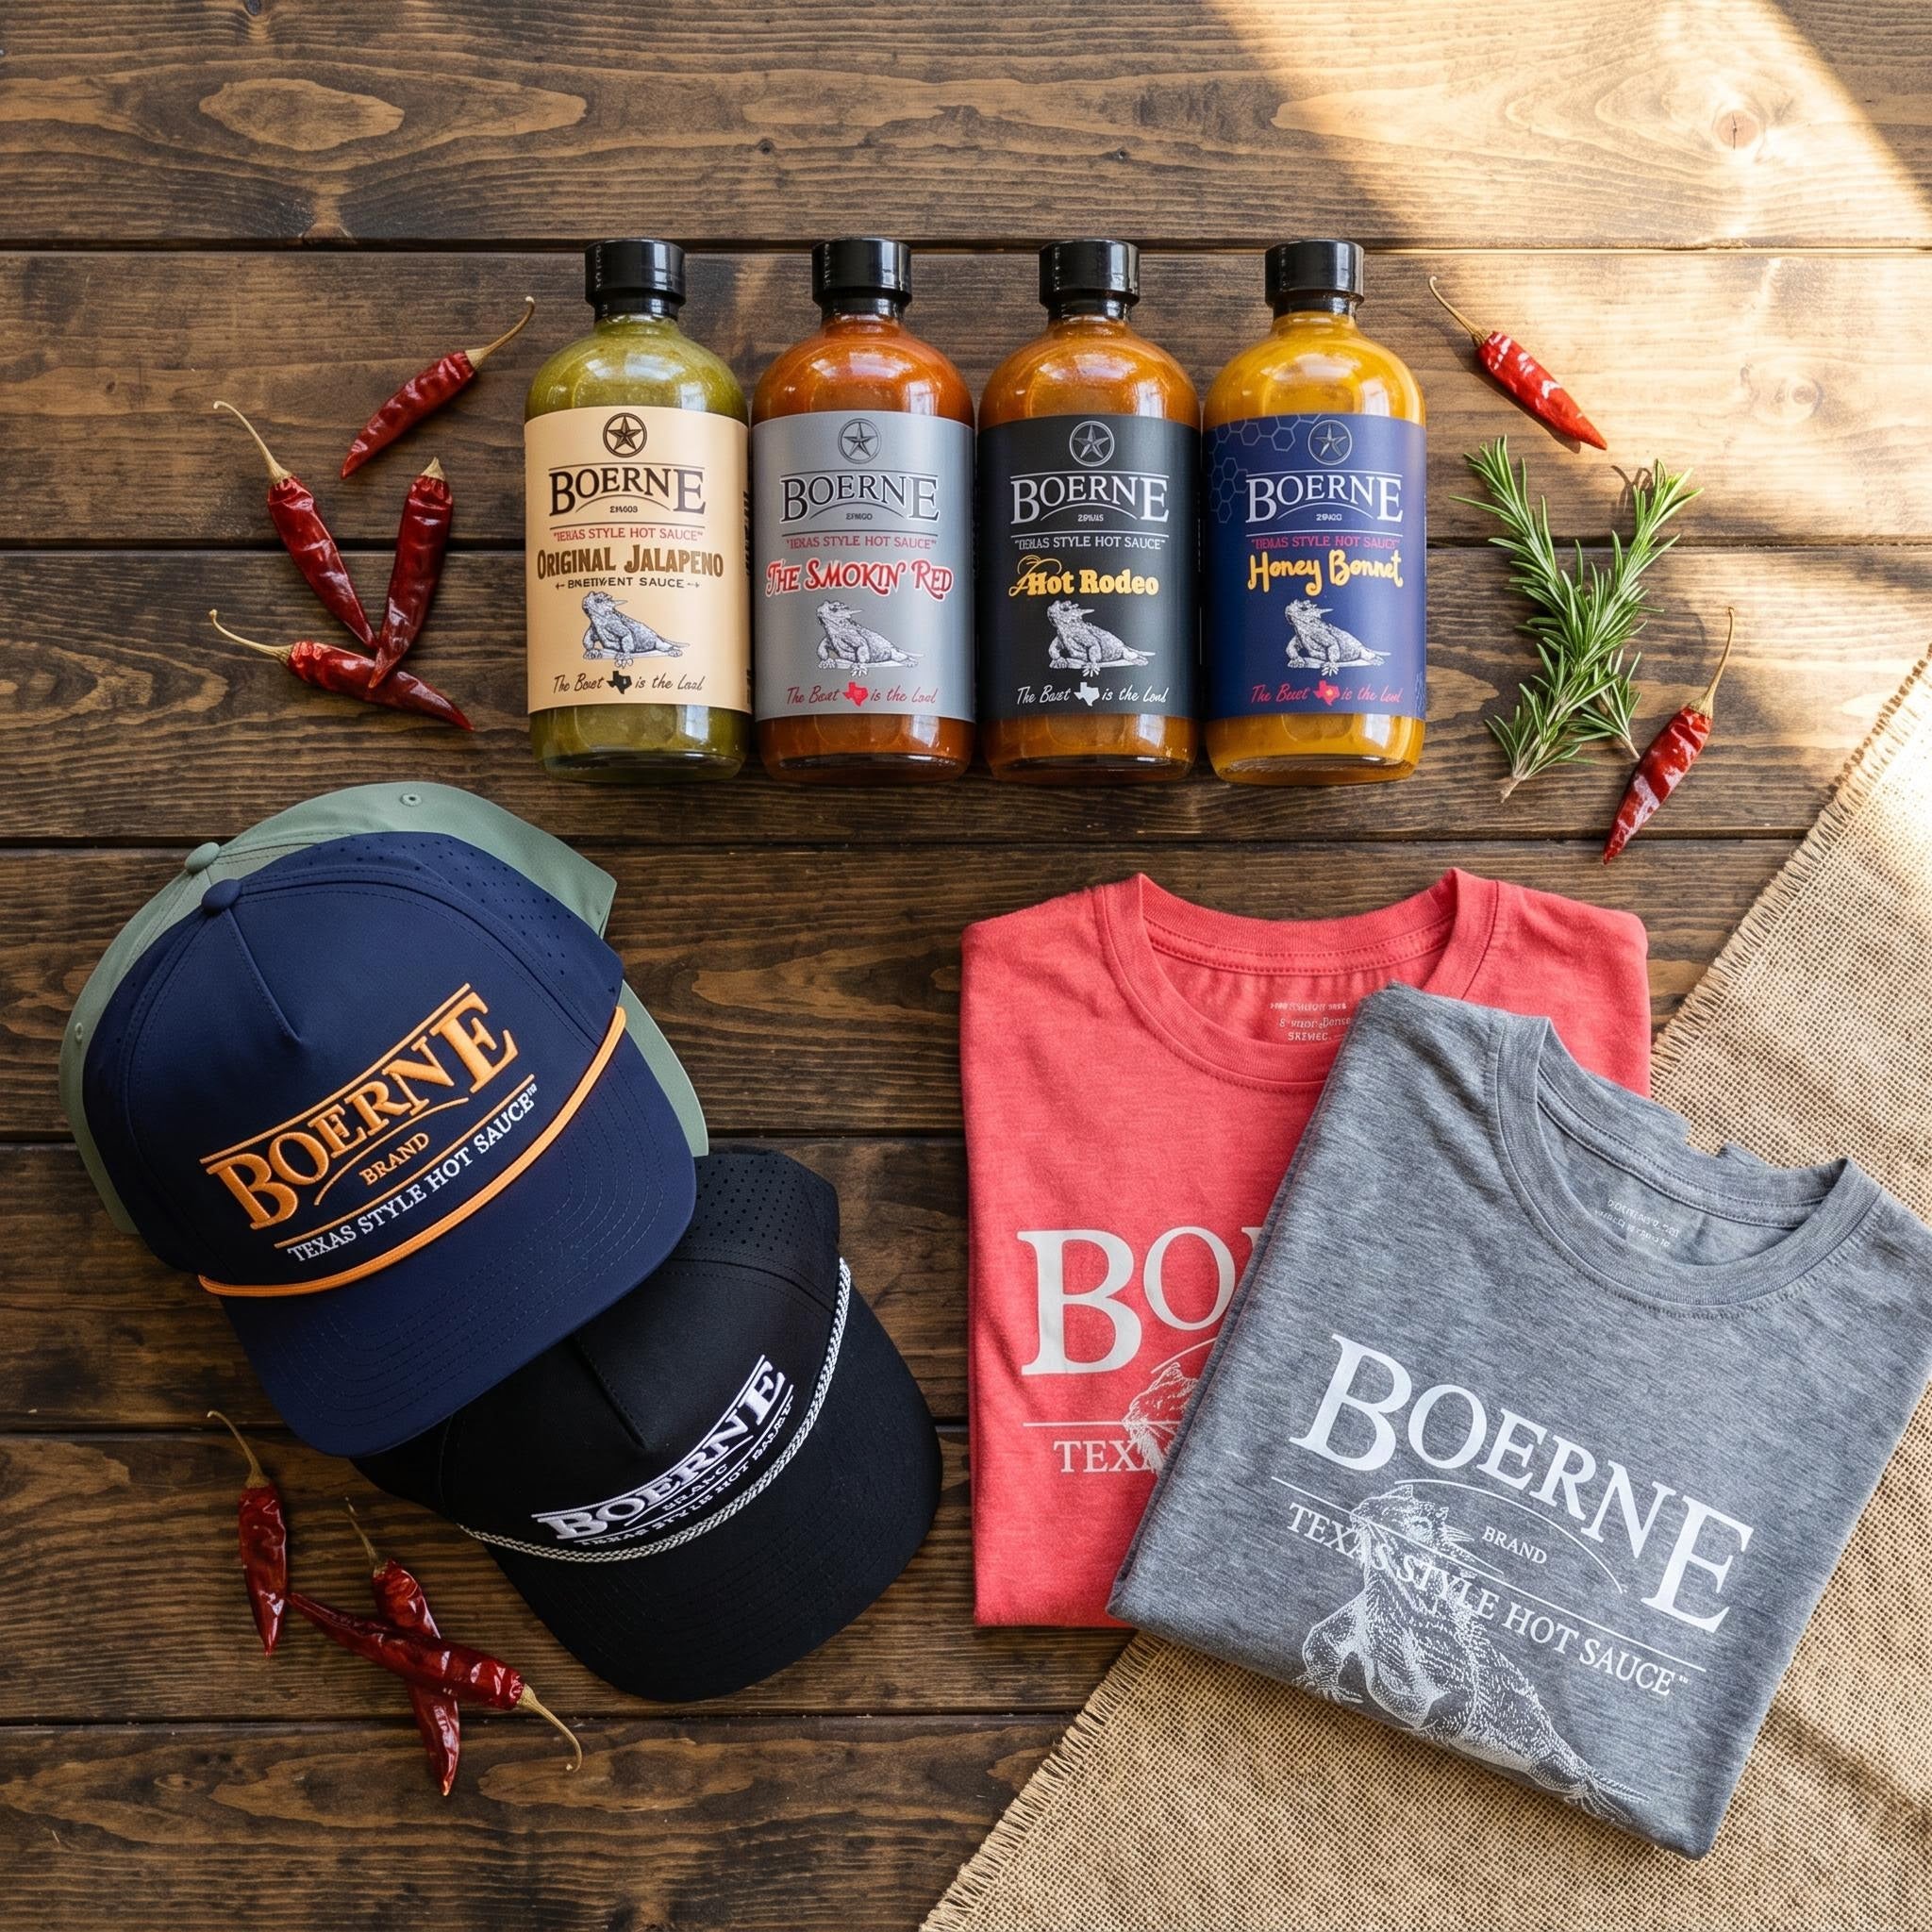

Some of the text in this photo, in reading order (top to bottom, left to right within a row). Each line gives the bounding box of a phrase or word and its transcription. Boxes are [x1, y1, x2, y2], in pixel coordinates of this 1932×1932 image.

[549, 468, 706, 517] BOERNE
[780, 475, 940, 523] BOERNE
[1010, 475, 1169, 525] BOERNE
[1245, 475, 1404, 524] BOERNE
[589, 527, 625, 539] STYLE
[630, 527, 656, 539] HOT
[823, 536, 860, 547] STYLE
[865, 536, 891, 547] HOT
[1053, 536, 1091, 548] STYLE
[1094, 536, 1122, 548] HOT
[537, 544, 724, 580] ORIGINAL JALAPENO
[640, 577, 685, 589] SAUCE
[1008, 555, 1160, 598] Hot Rodeo
[1246, 549, 1405, 597] Honey Bonnet
[635, 676, 646, 689] is
[651, 674, 674, 690] the
[787, 687, 806, 705] The
[870, 689, 882, 702] is
[887, 685, 908, 702] the
[1017, 686, 1037, 705] The
[1101, 688, 1114, 701] is
[1118, 684, 1141, 702] the
[1357, 684, 1377, 701] the
[206, 991, 519, 1230] BOERNE
[358, 1132, 430, 1186] BRAND
[287, 1224, 358, 1262] TEXAS
[358, 1184, 427, 1236] STYLE
[424, 1147, 475, 1193] HOT
[1017, 1225, 1266, 1375] BO
[537, 1360, 786, 1541] BOERNE
[1289, 1333, 1755, 1634] BOERNE
[1481, 1525, 1548, 1566] BRAND
[1287, 1502, 1394, 1571] TEXAS
[1396, 1555, 1500, 1620] STYLE
[1501, 1601, 1581, 1655] HOT
